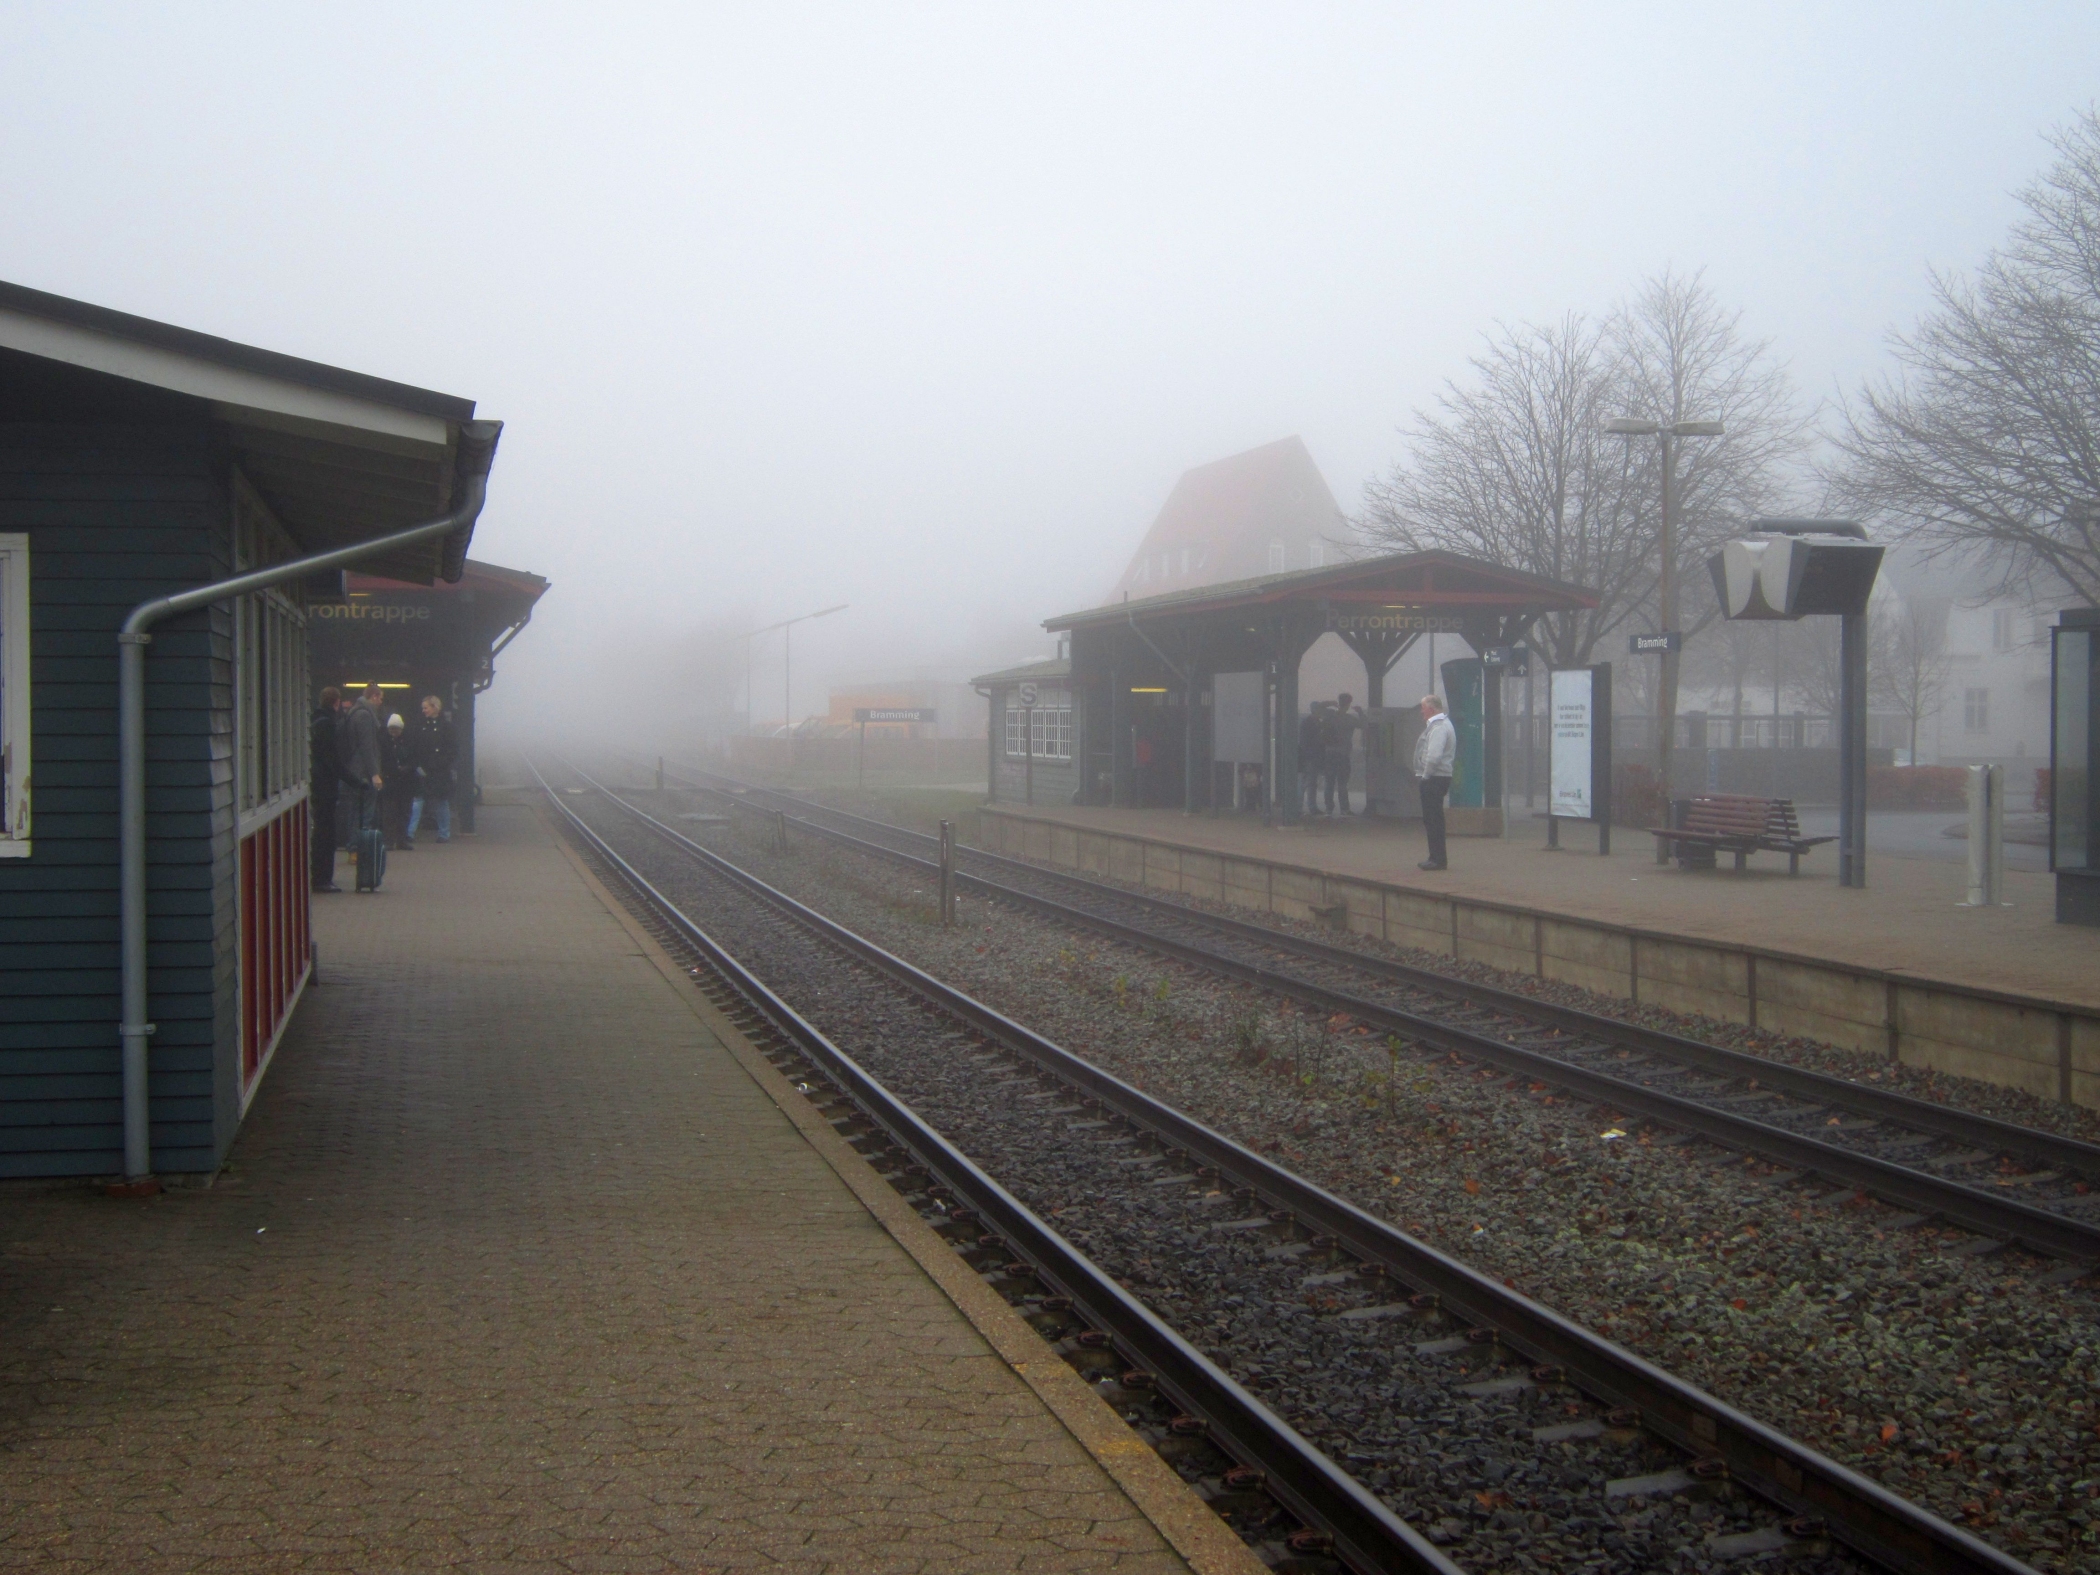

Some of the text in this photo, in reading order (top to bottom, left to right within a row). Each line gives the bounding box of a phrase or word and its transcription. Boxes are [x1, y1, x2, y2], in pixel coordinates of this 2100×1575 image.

[1326, 609, 1464, 632] Perrontrappe
[1637, 636, 1668, 649] Bramming
[482, 660, 489, 669] 2
[1021, 684, 1037, 705] S
[870, 710, 920, 720] Bramming
